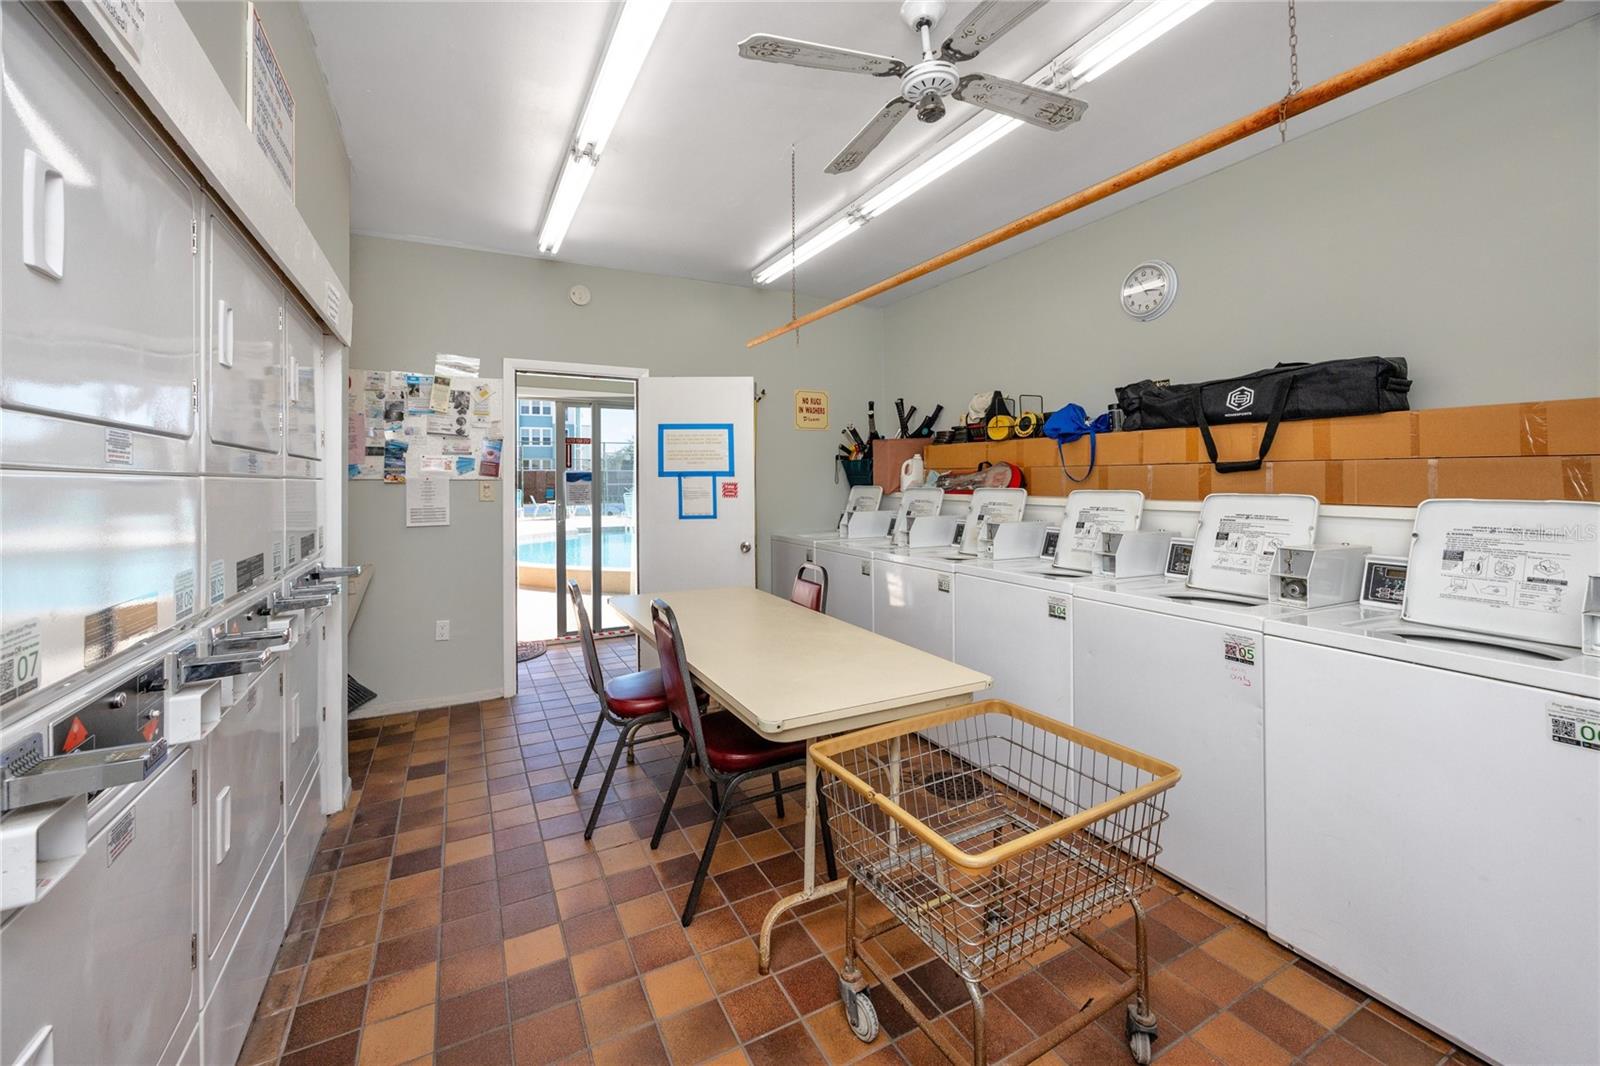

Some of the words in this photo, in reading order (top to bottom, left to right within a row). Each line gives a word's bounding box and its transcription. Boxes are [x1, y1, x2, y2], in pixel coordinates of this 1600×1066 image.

[802, 397, 809, 405] NO
[798, 406, 804, 414] IN
[805, 406, 826, 415] WASHERS
[1056, 606, 1066, 616] 04
[1238, 647, 1254, 660] 05
[17, 651, 38, 681] 07
[1580, 725, 1600, 742] 0
